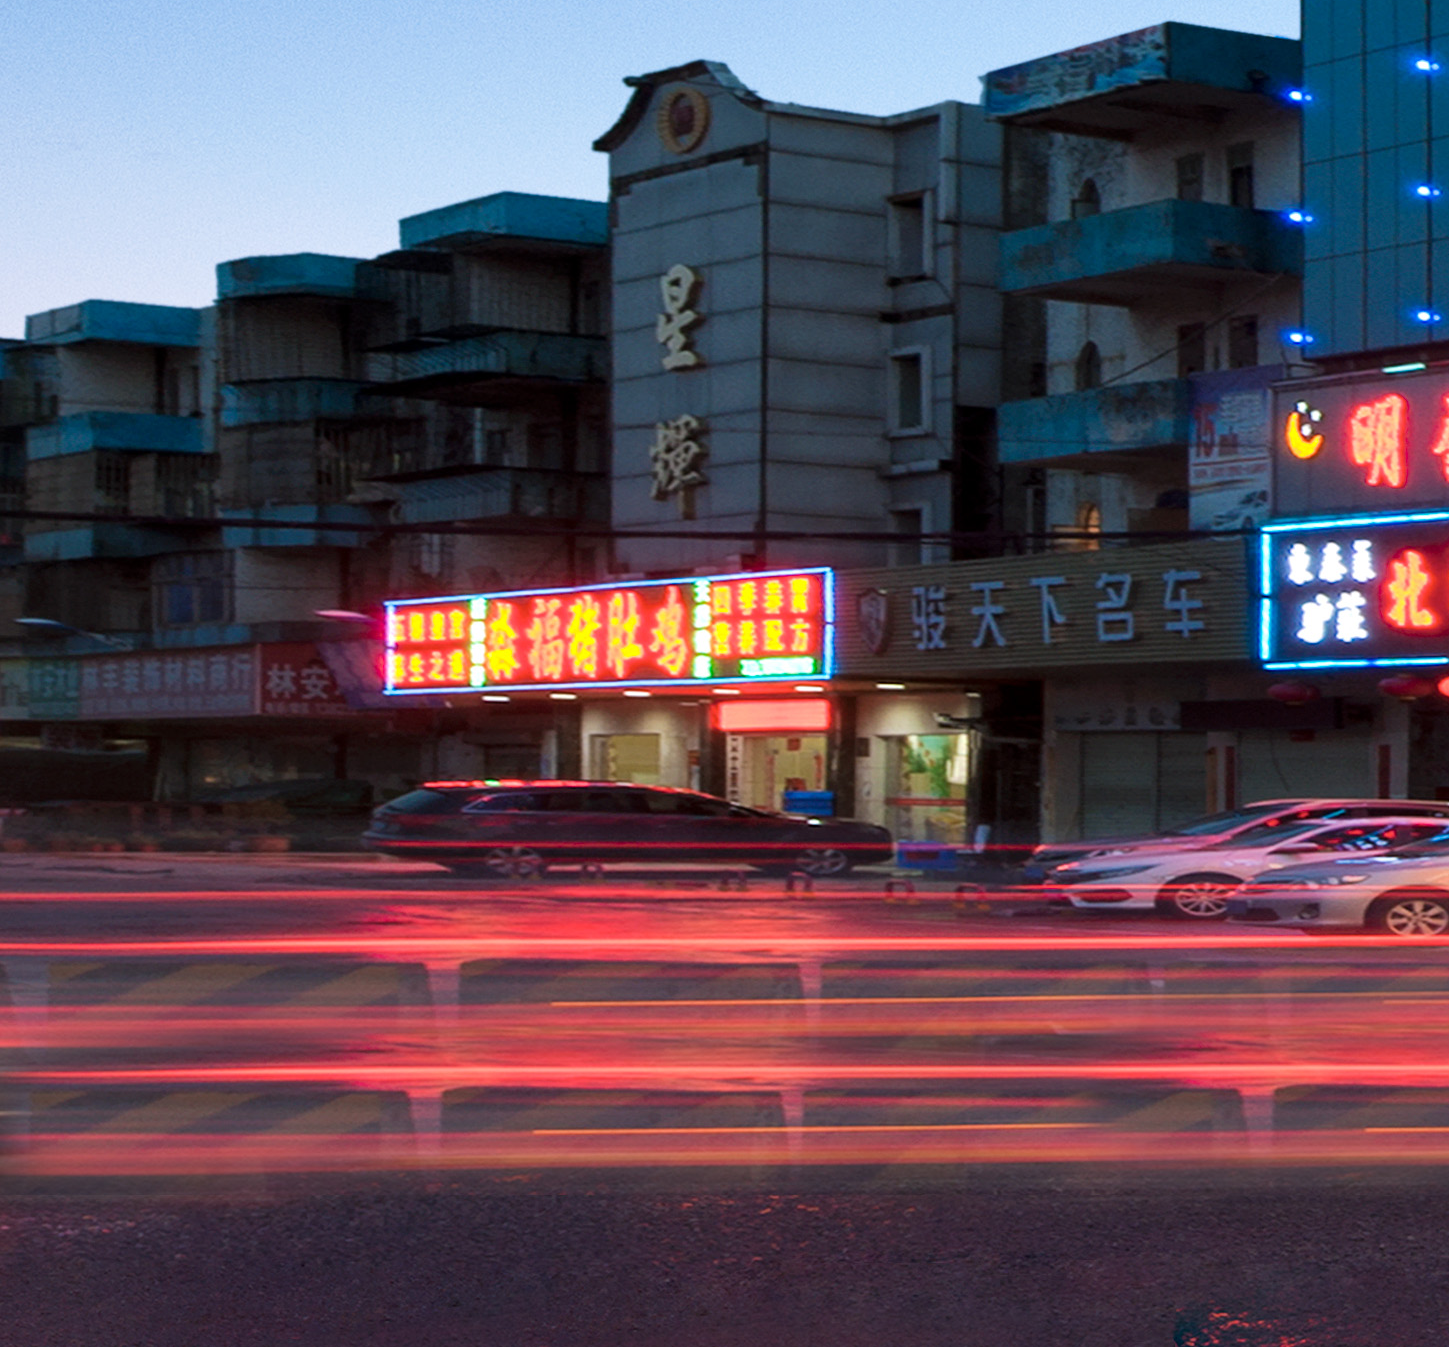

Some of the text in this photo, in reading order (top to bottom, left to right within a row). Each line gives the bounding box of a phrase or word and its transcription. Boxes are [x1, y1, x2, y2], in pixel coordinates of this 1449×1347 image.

[911, 568, 1206, 650] 骏天下名车
